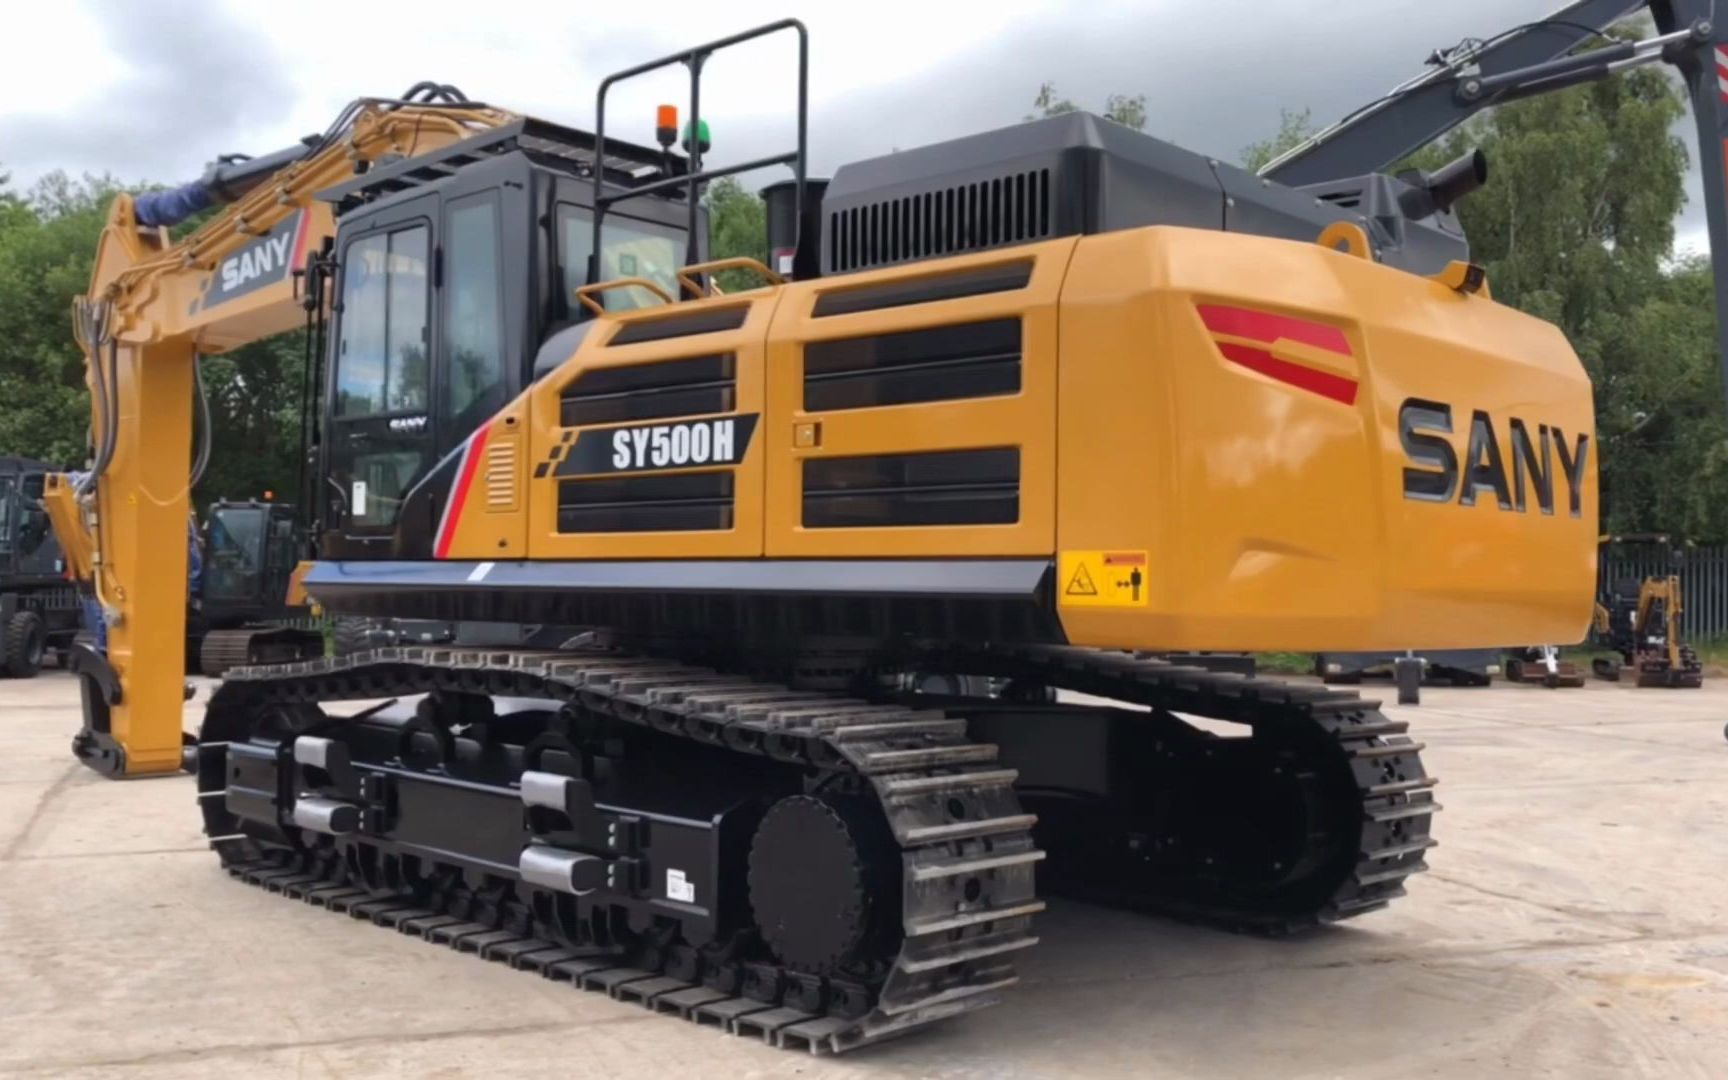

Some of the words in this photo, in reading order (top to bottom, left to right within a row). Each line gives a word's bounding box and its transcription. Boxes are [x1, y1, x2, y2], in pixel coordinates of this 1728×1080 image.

[222, 232, 290, 292] SANY
[612, 420, 734, 469] SY500H
[1398, 397, 1589, 519] SANY
